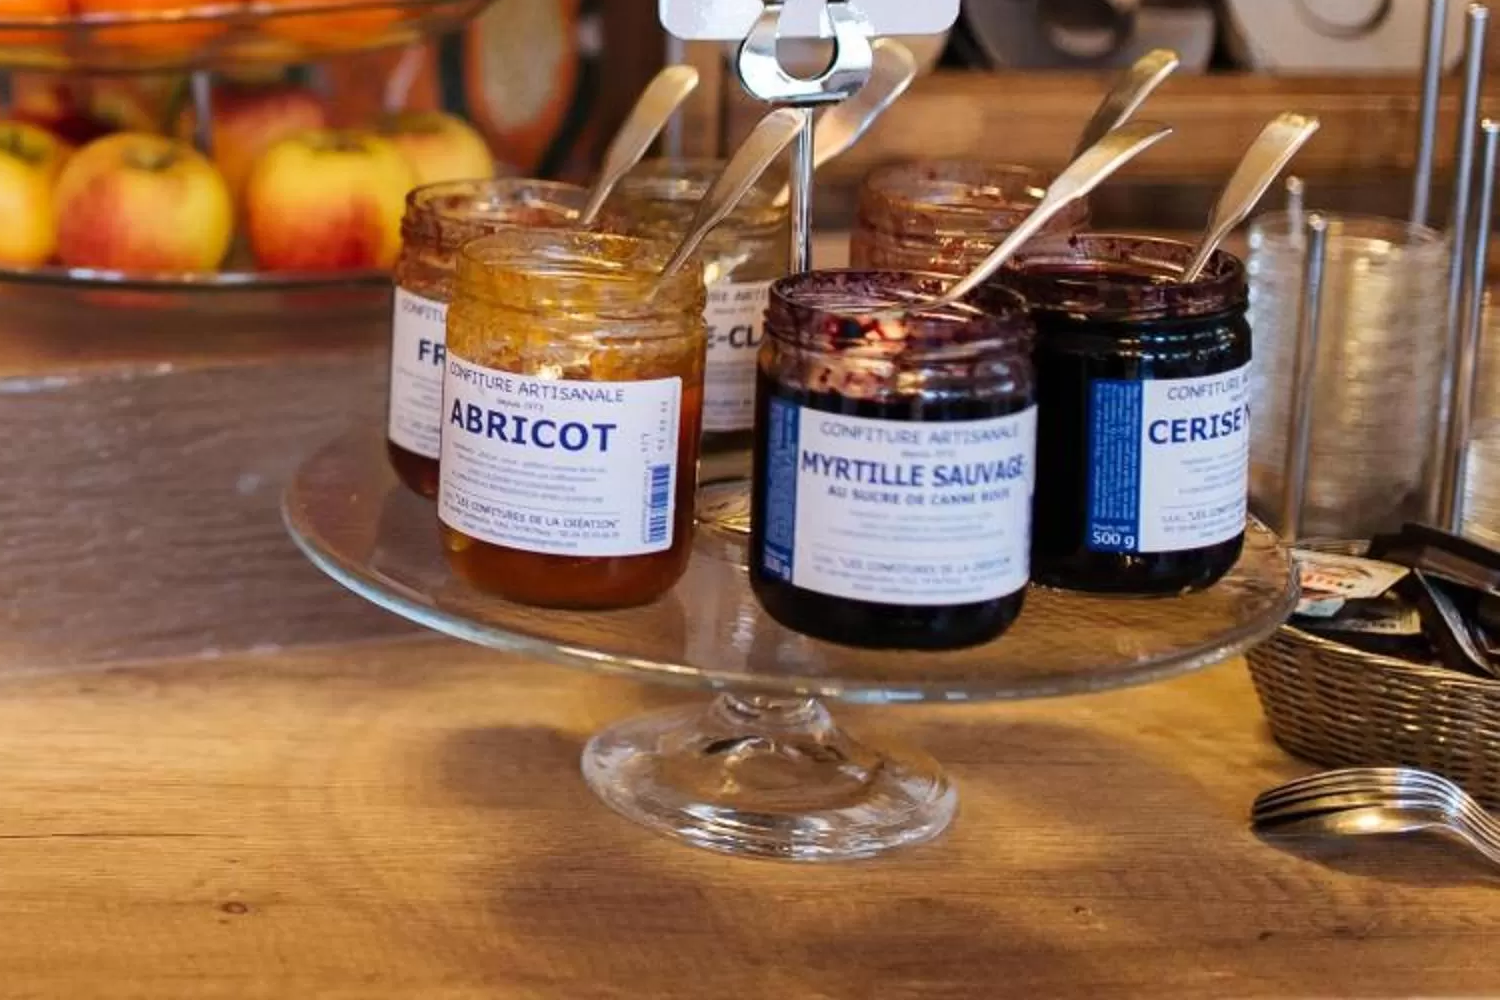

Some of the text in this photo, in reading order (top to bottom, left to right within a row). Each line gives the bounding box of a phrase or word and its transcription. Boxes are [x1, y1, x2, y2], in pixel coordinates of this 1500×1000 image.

[450, 361, 512, 393] CONFITURE
[518, 382, 624, 403] ARTISANALE
[451, 398, 617, 453] ABRICOT
[820, 420, 1020, 446] CONFITURE ARTISANALE
[1148, 406, 1241, 445] CERISE
[801, 449, 1026, 488] MYRTILLE SAUVAGE
[1092, 531, 1135, 549] 500 g
